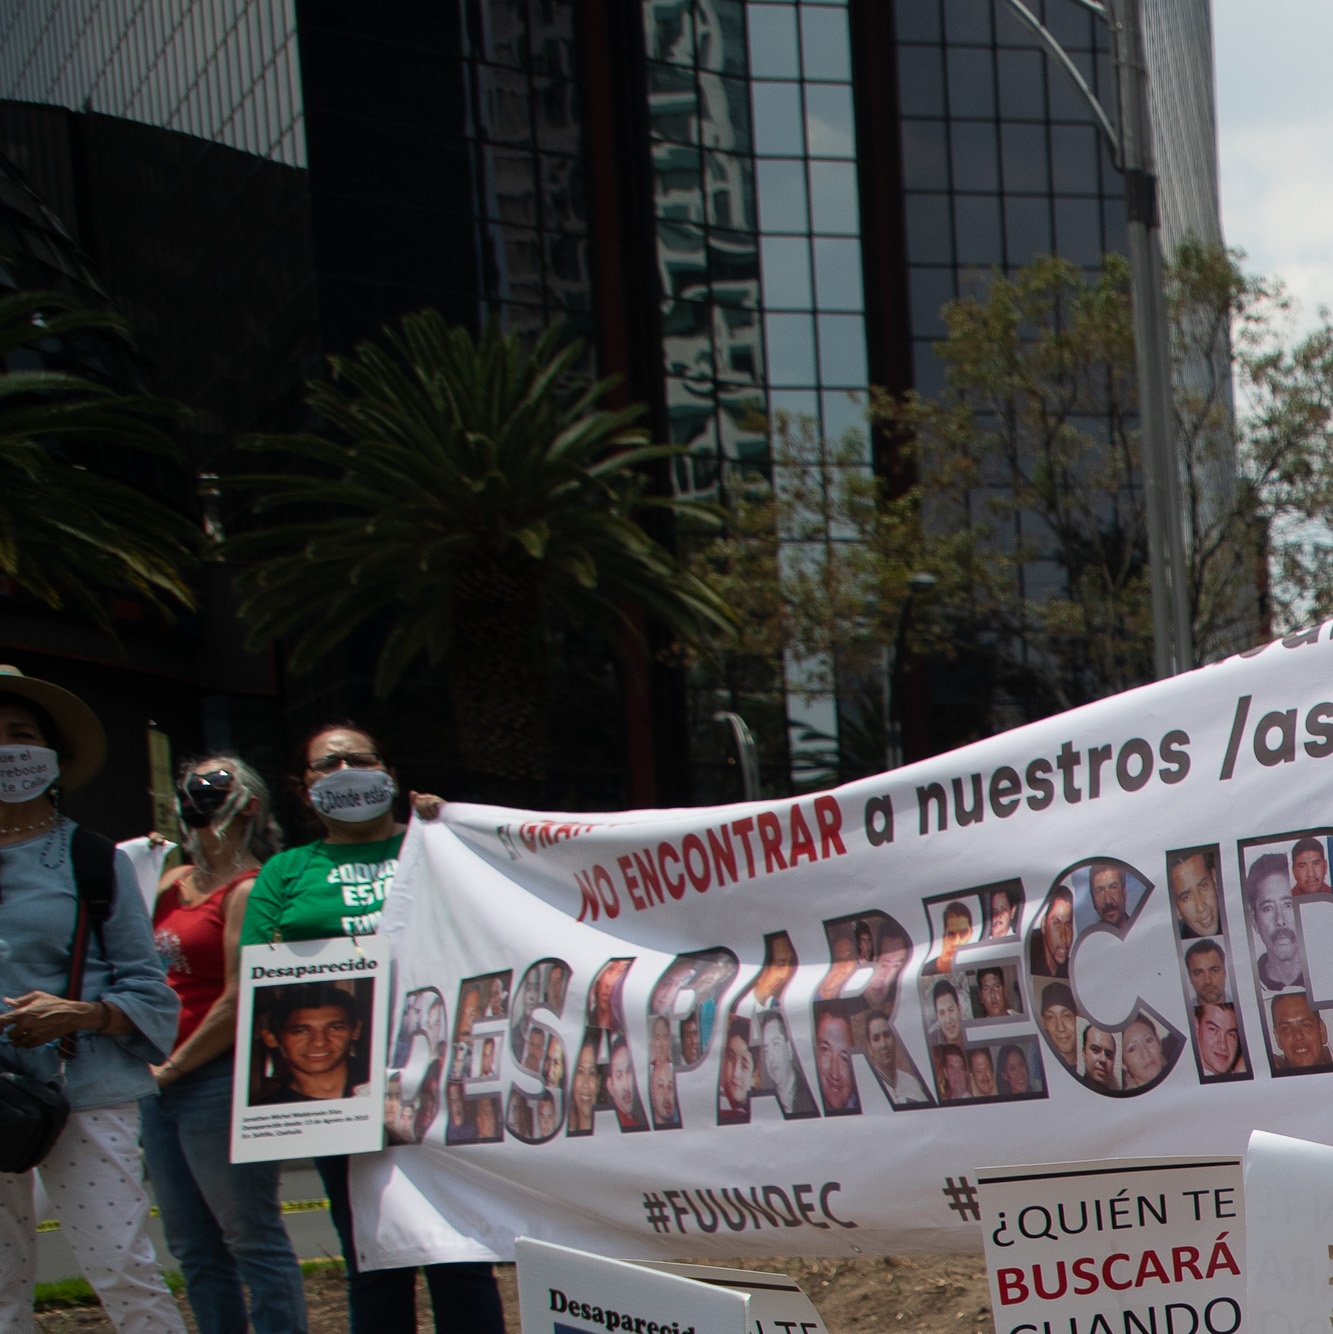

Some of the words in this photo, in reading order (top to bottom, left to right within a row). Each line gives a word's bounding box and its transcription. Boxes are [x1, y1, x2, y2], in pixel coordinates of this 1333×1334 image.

[573, 865, 620, 923] NO
[617, 795, 847, 912] ENCONTRAR
[864, 792, 895, 848] a
[918, 729, 1192, 836] nuestros
[251, 958, 378, 980] Desaparecido
[643, 1181, 860, 1235] #FUUNDEC
[991, 1187, 1168, 1248] ¿QUIÉN
[1182, 1187, 1237, 1223] TE
[996, 1231, 1242, 1306] BUSCARÁ
